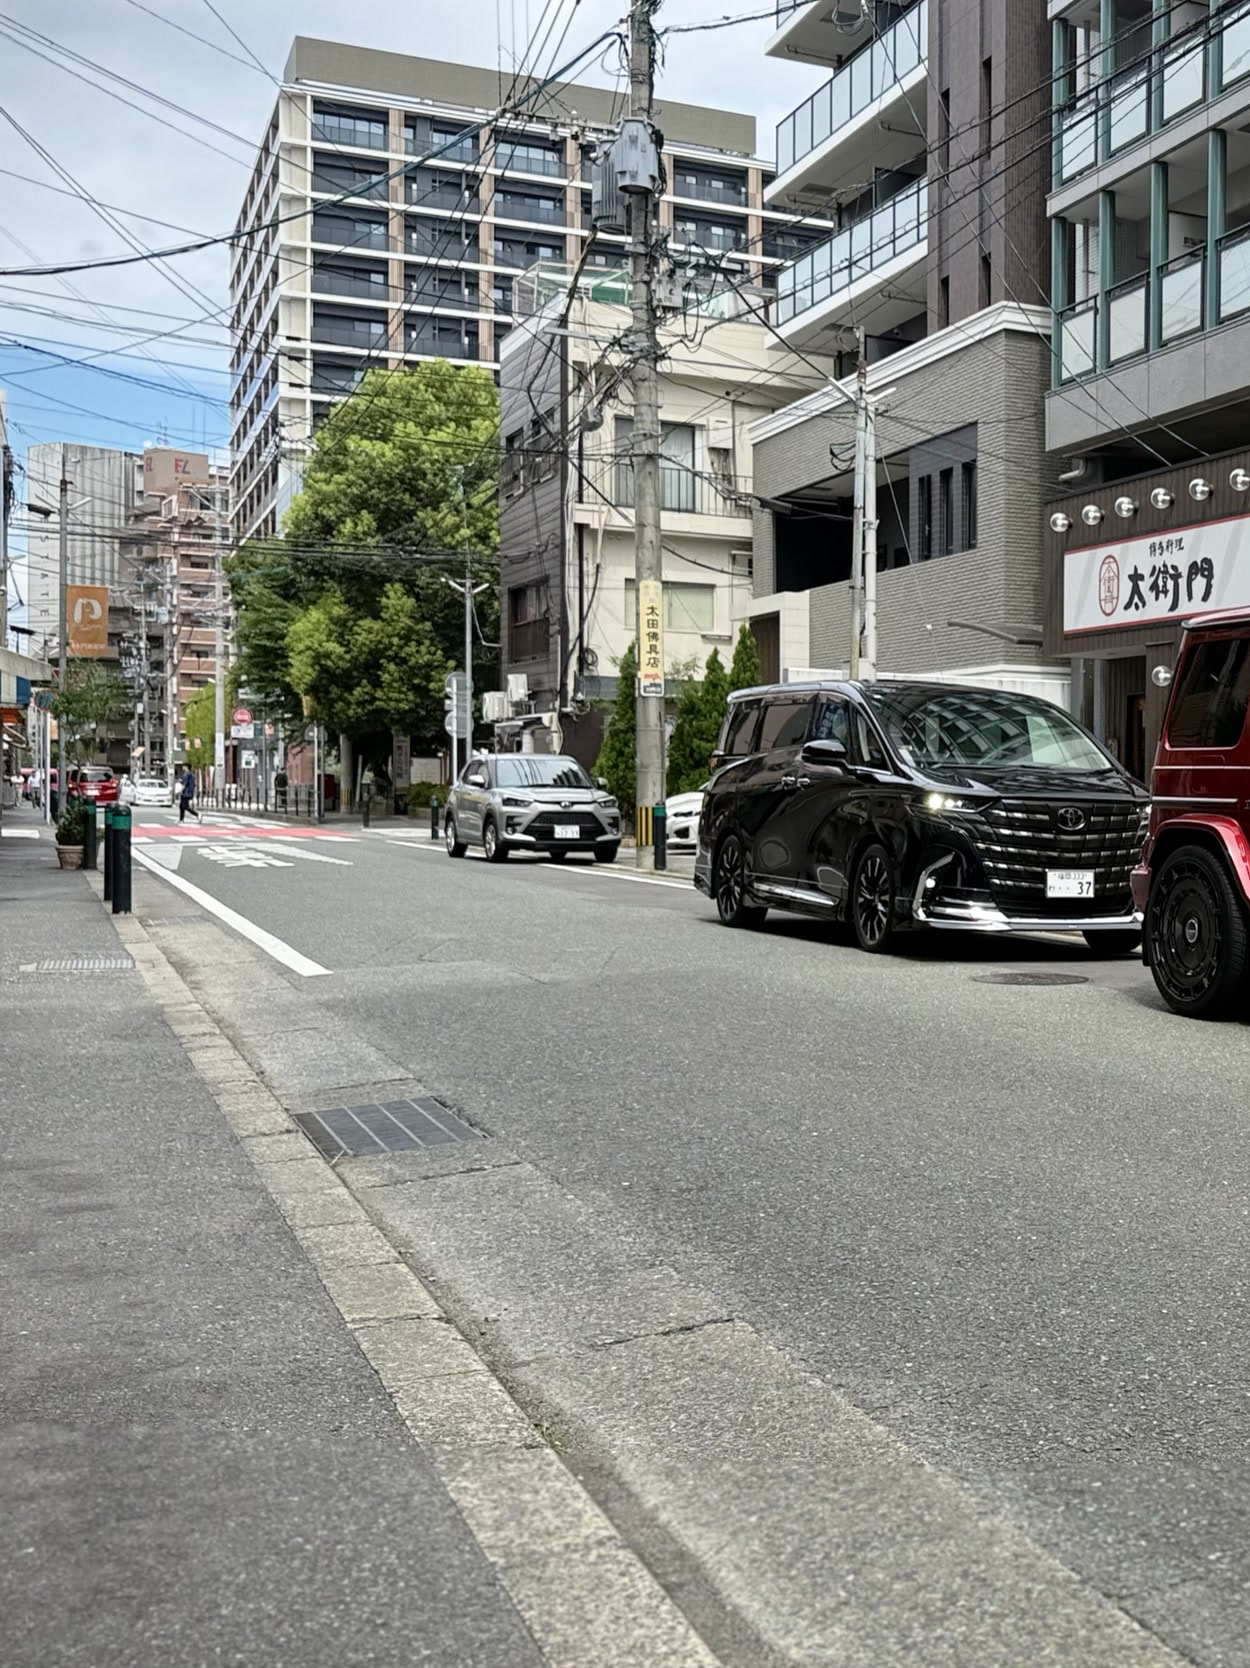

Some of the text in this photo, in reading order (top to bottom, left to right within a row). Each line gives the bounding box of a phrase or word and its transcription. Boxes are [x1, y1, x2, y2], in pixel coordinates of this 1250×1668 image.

[646, 605, 660, 668] 太田佛具店
